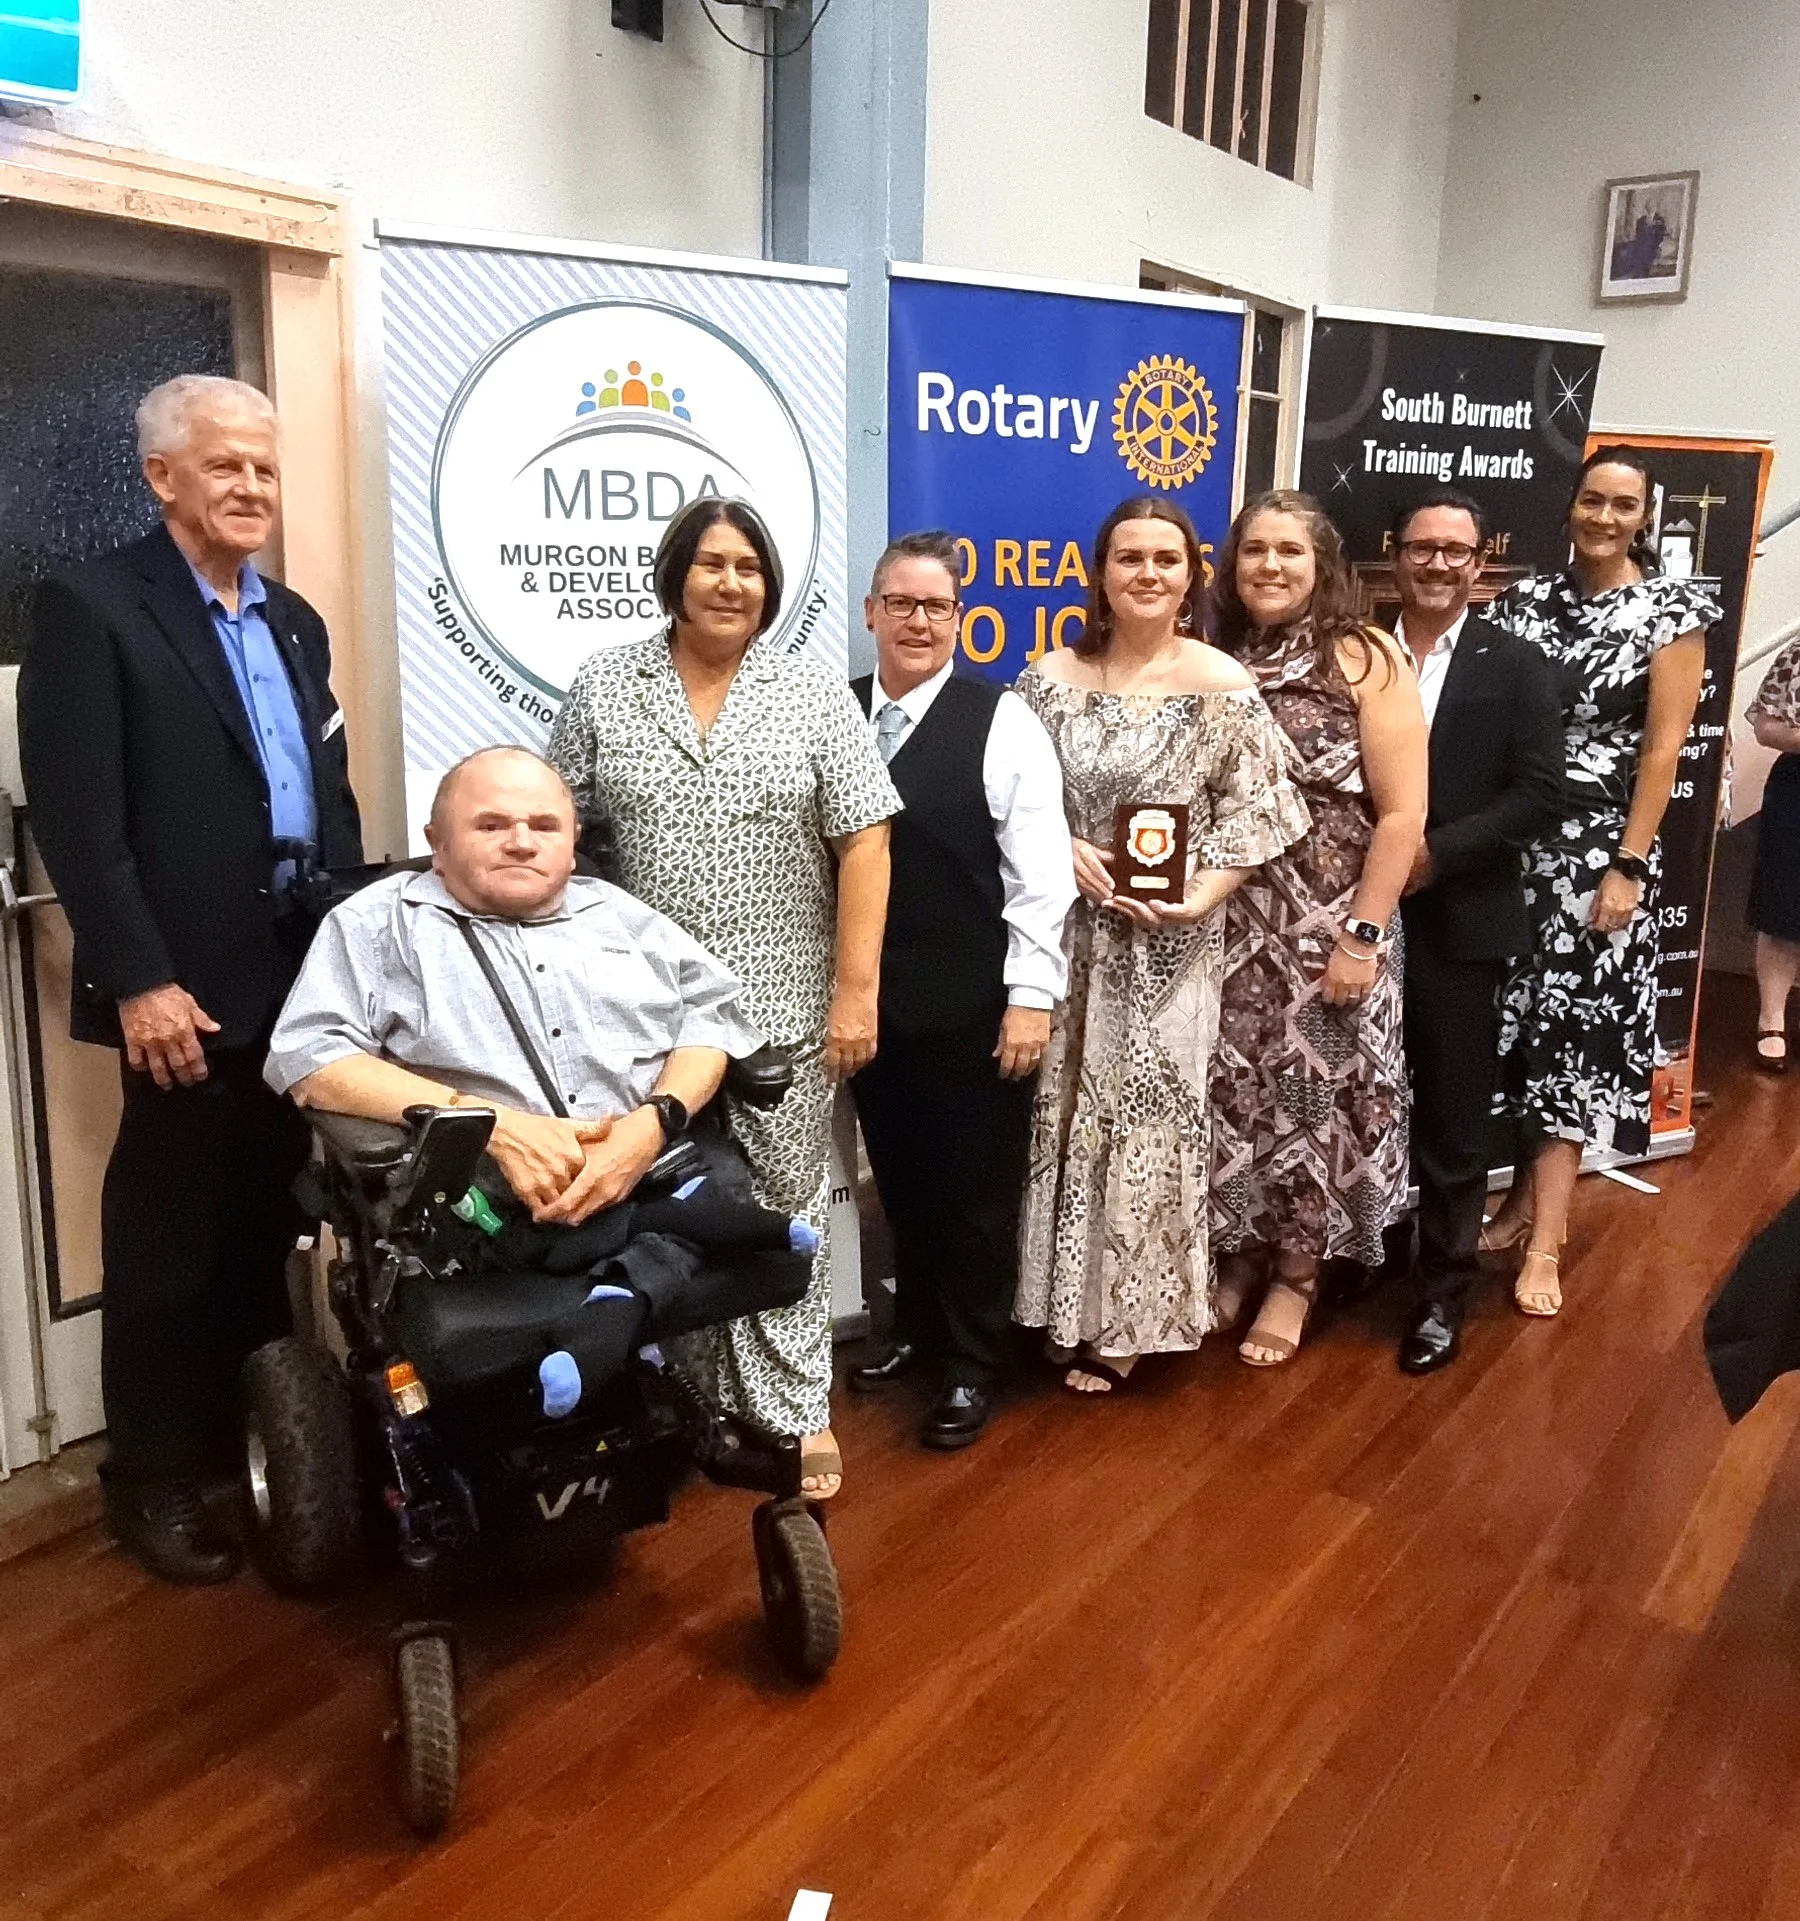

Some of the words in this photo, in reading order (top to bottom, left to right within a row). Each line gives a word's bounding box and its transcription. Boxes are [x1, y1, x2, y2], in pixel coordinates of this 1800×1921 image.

[1144, 370, 1189, 385] ROTARY
[917, 371, 1100, 454] Rotary
[1381, 387, 1445, 424] South
[1451, 393, 1532, 430] Burnett
[1129, 441, 1205, 475] INTERNATIONAL
[1363, 439, 1454, 483] Training
[1458, 445, 1534, 480] Awards
[500, 544, 627, 567] MURGON
[520, 571, 539, 593] &
[549, 571, 656, 593] DEVELO
[557, 597, 661, 619] ASSOC.
[961, 605, 1006, 663] O
[1025, 606, 1087, 663] JO
[518, 693, 554, 724] tho
[1699, 723, 1724, 737] time
[1657, 949, 1699, 965] g.com.au
[536, 1476, 610, 1520] V4
